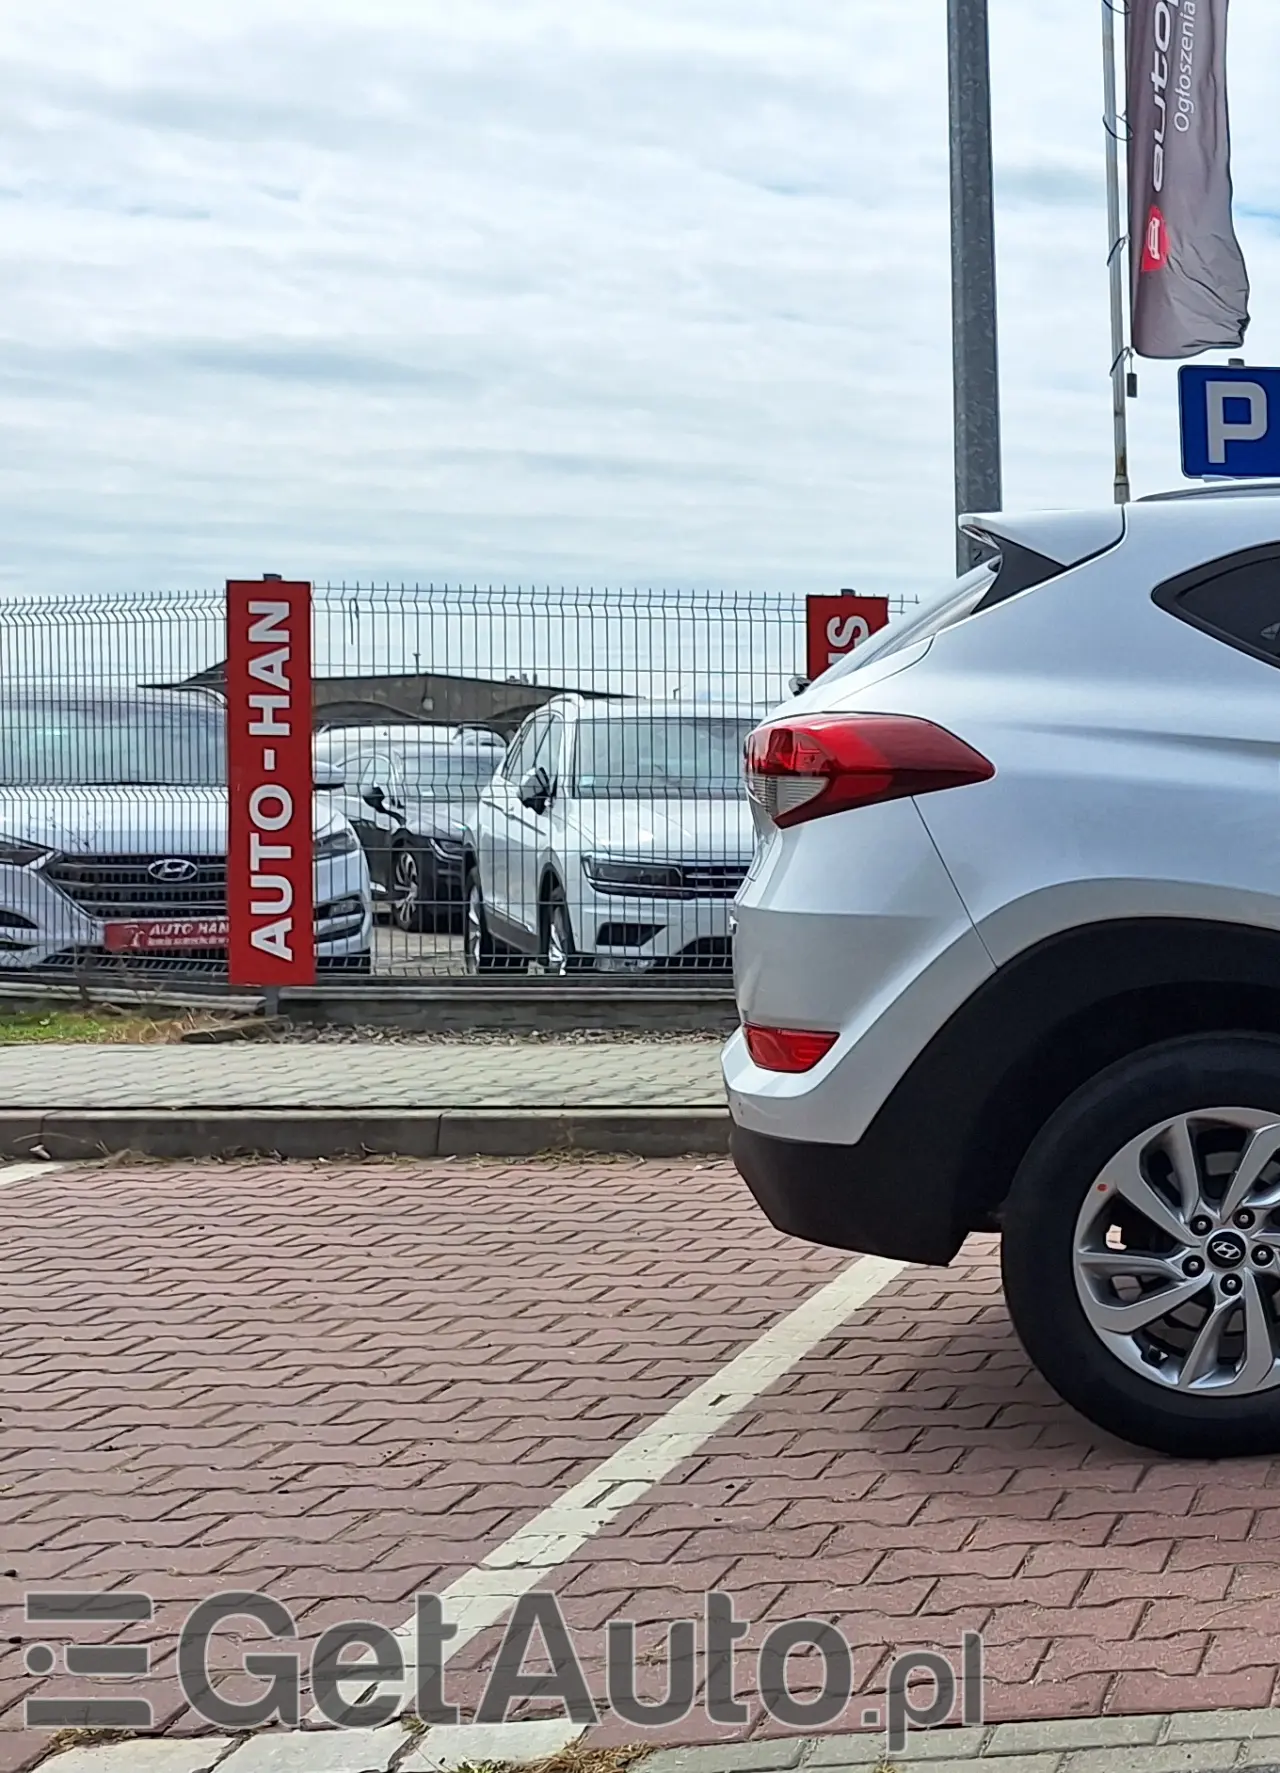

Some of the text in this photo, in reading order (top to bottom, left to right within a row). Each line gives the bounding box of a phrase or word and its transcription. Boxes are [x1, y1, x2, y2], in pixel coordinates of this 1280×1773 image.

[1151, 0, 1180, 192] auto
[1173, 0, 1196, 132] Ogłoszenia
[1205, 380, 1268, 464] P
[248, 601, 294, 962] AUTO-HAN
[148, 923, 194, 936] AUTO
